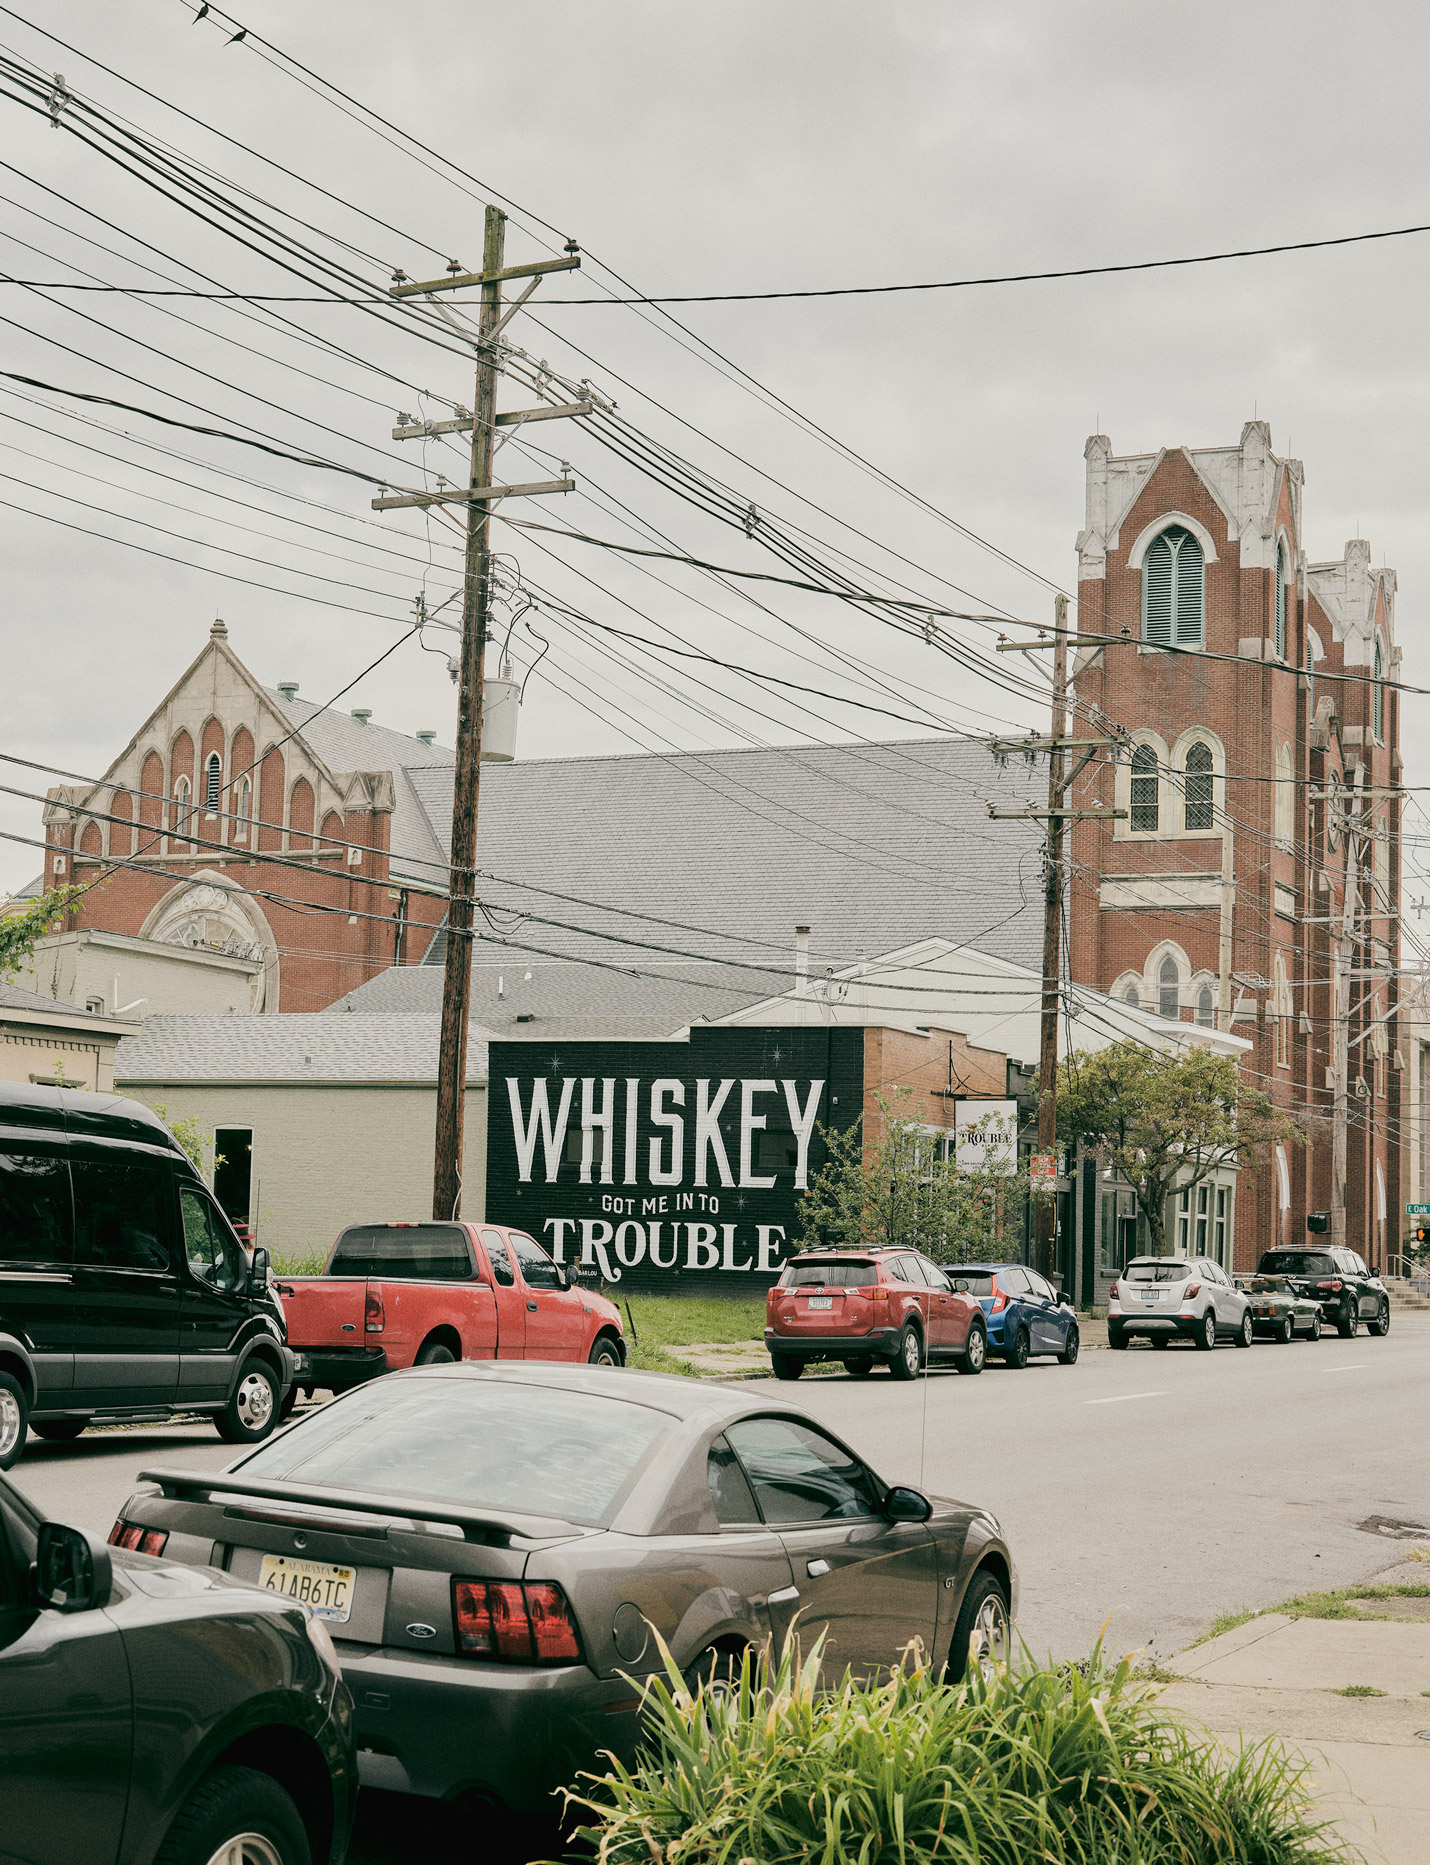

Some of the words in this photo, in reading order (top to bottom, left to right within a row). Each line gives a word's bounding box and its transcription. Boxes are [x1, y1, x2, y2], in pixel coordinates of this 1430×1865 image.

[505, 1077, 826, 1190] WHISKEY
[602, 1194, 635, 1215] GOT
[642, 1196, 668, 1215] ME
[1414, 1205, 1428, 1213] Oak
[543, 1218, 787, 1283] TROUBLE
[286, 1562, 331, 1576] ALABAMA
[945, 1576, 956, 1588] GT
